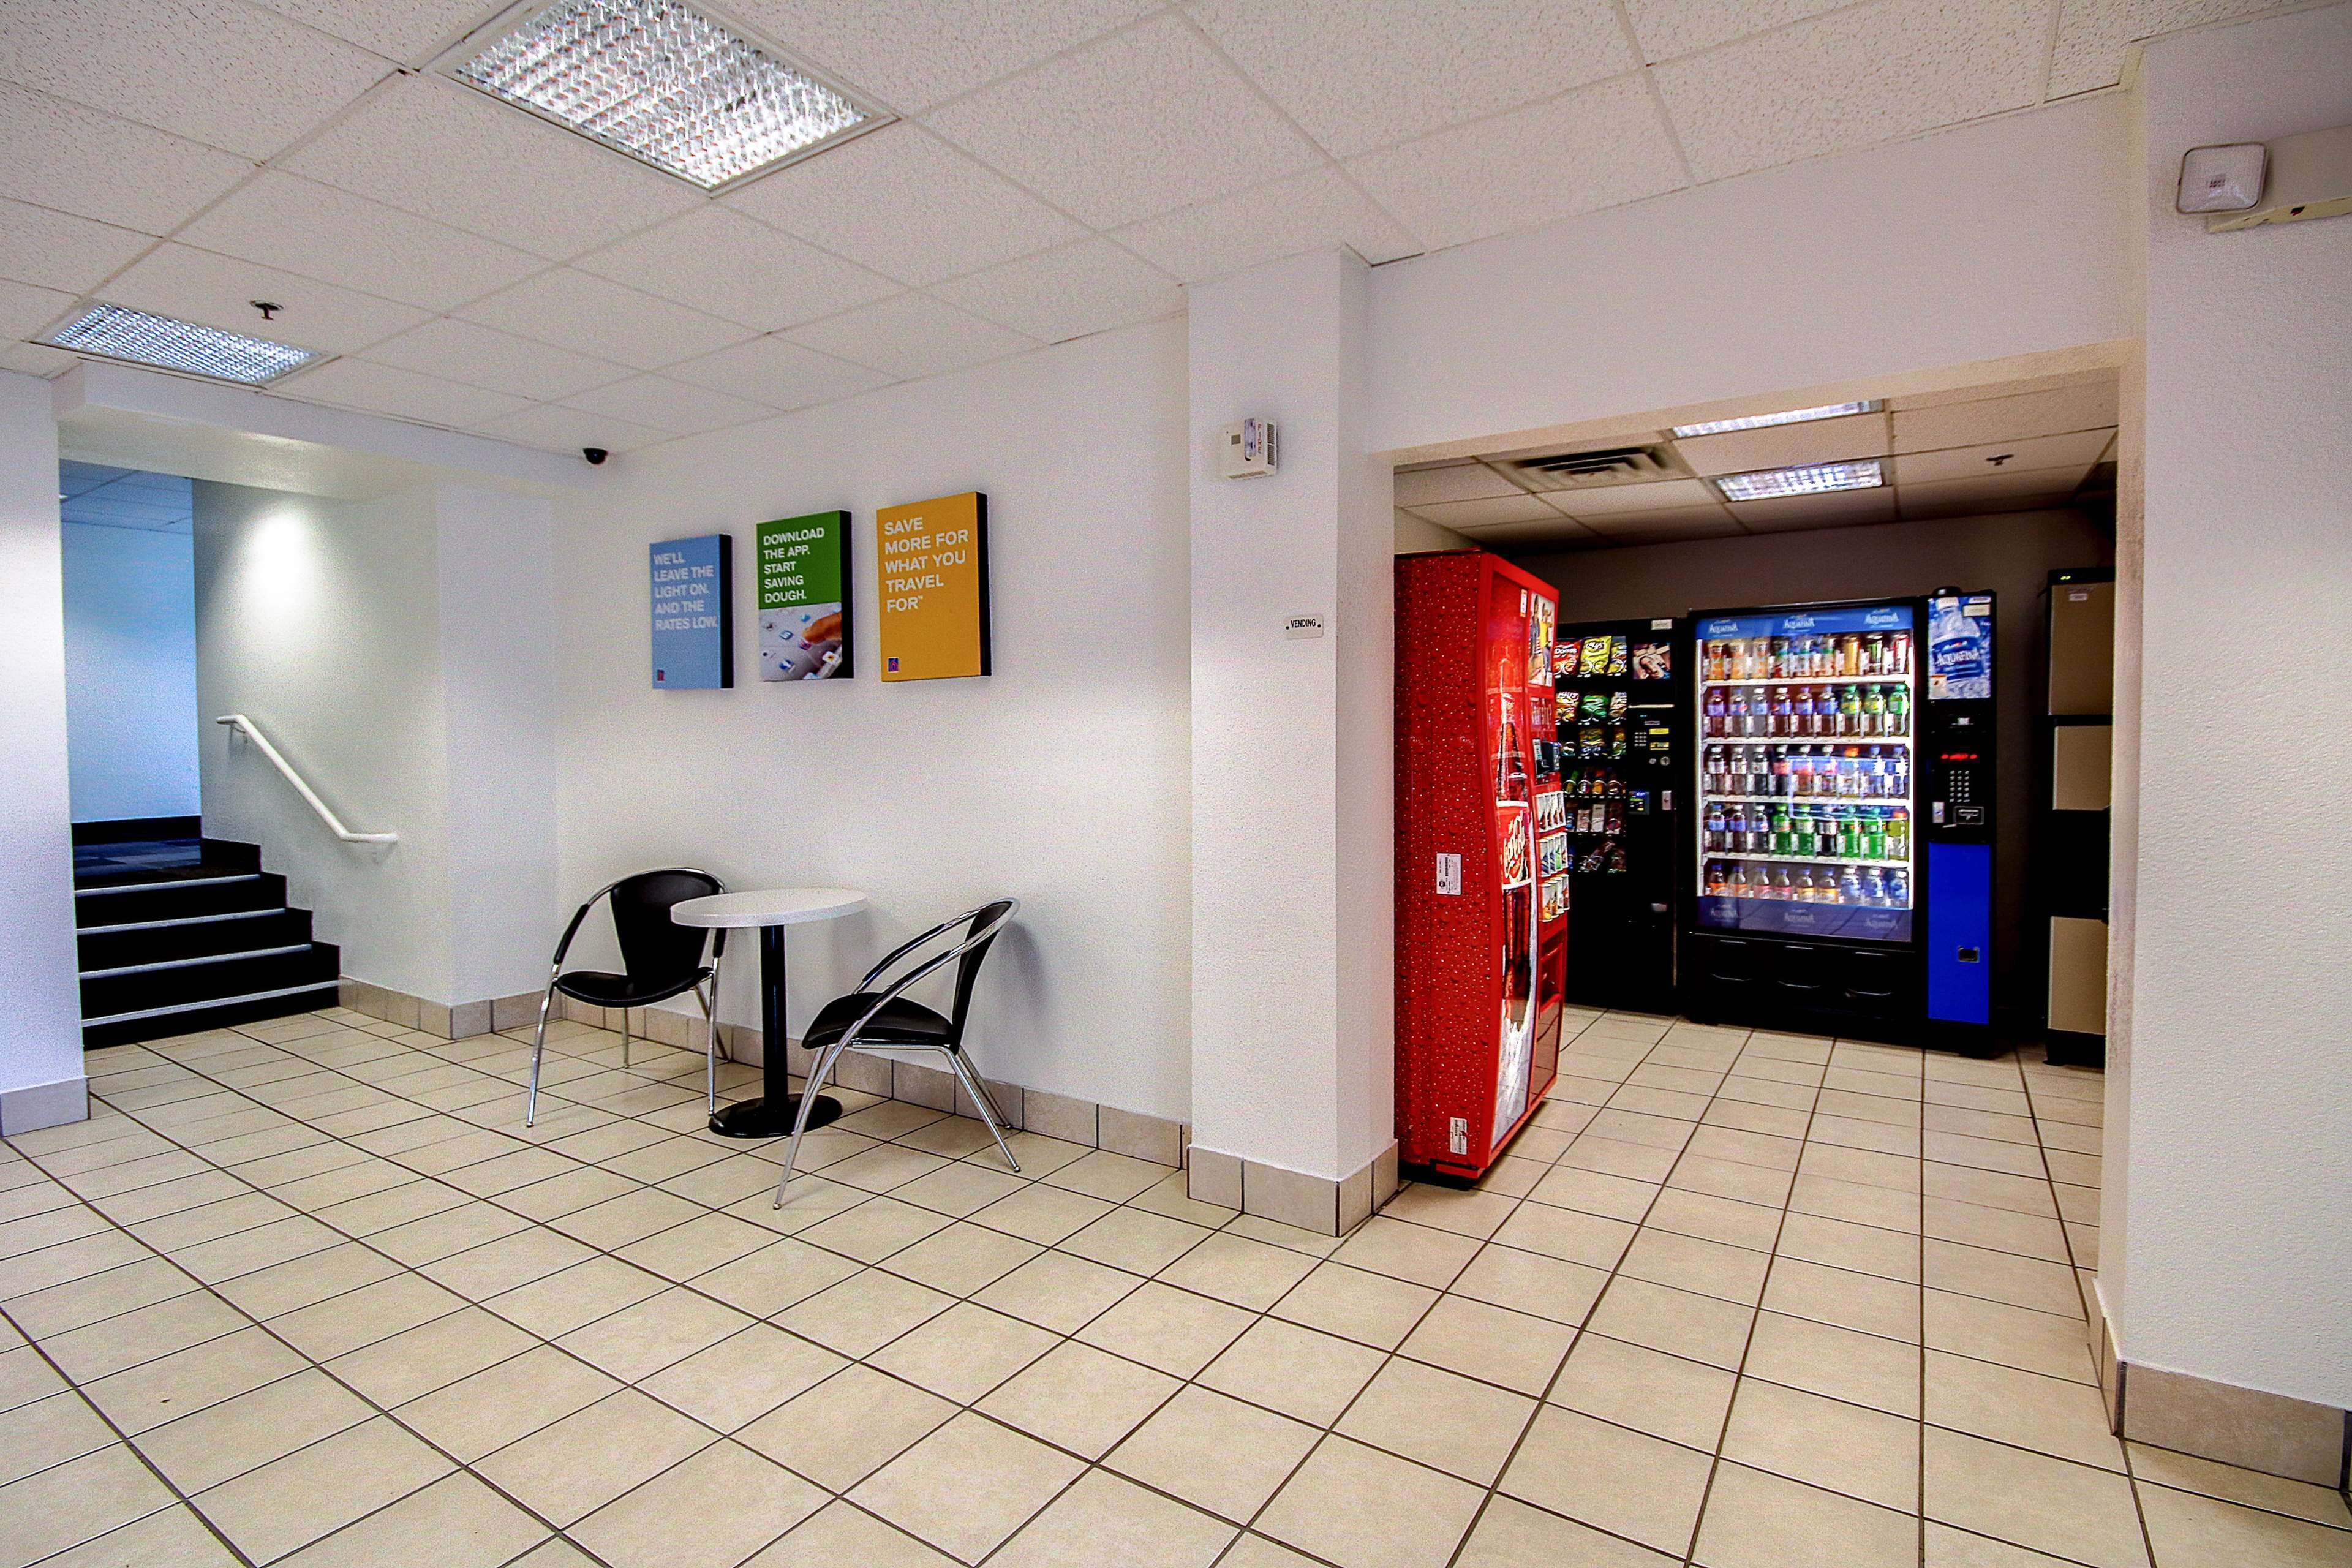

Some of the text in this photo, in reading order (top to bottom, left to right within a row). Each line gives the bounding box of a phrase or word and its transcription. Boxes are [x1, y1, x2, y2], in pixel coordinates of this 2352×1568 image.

[884, 517, 924, 535] SAVE
[763, 527, 825, 545] DOWNLOAD
[884, 529, 968, 555] MORE FOR
[764, 545, 810, 559] THE APP.
[764, 561, 796, 575] START
[885, 550, 966, 574] WHAT YOU
[654, 565, 714, 582] LEAVE THE
[764, 575, 804, 589] SAVING
[886, 574, 944, 593] TRAVEL
[655, 582, 710, 598] LIGHT ON.
[764, 590, 807, 603] DOUGH.
[655, 600, 704, 614] AND THE
[655, 617, 690, 631] RATES
[1291, 618, 1316, 628] VENDING
